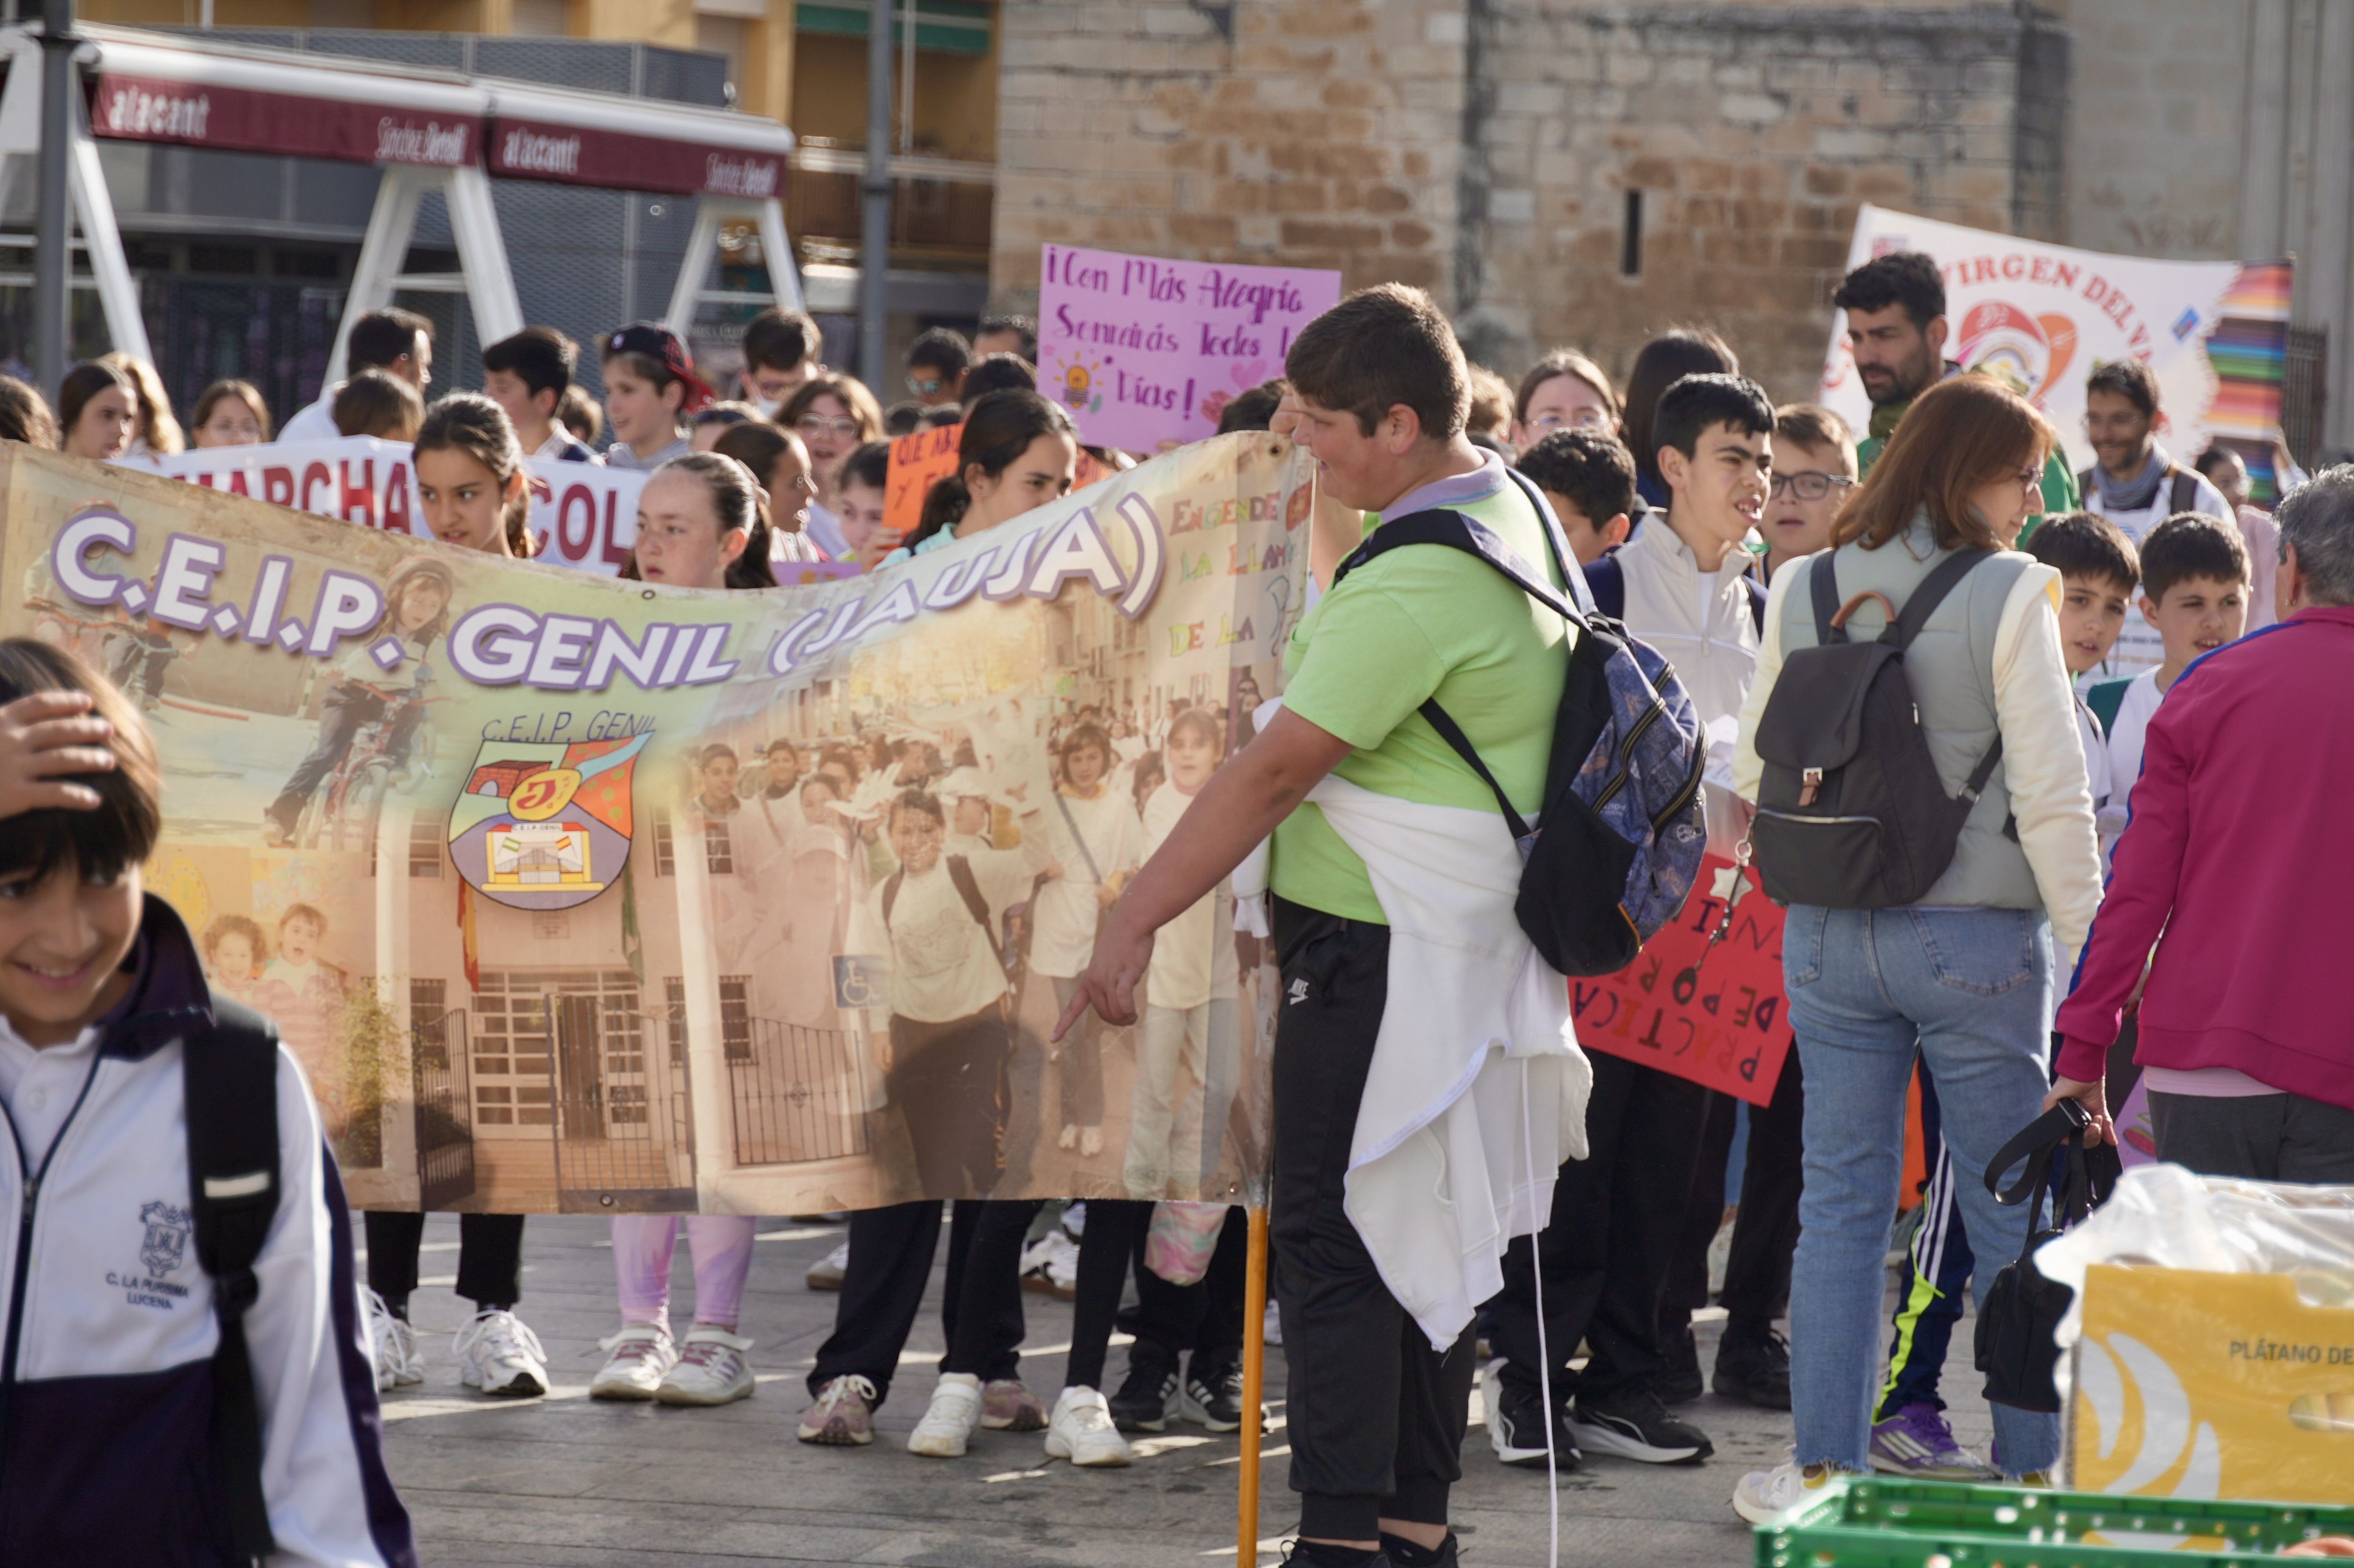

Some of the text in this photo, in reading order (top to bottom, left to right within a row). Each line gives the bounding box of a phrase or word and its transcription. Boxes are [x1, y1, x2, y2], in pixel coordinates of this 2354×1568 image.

[109, 85, 210, 139] alacant
[503, 127, 580, 175] alacant
[1123, 259, 1187, 303] Más
[1198, 270, 1305, 324] Alegría
[2082, 274, 2136, 332] DEL
[172, 459, 411, 535] RCHA
[1181, 551, 1212, 583] LA
[51, 510, 406, 670] C.E.I.P.
[447, 602, 741, 690] GENIL
[768, 492, 1165, 677] (JAUJA)
[1169, 620, 1204, 657] DE
[1217, 612, 1254, 647] LA
[482, 710, 656, 742] C.E.I.P. GENIL
[122, 1275, 138, 1288] LA
[127, 1291, 173, 1310] LUCENA
[2229, 1338, 2354, 1365] PLÁTANO DE
